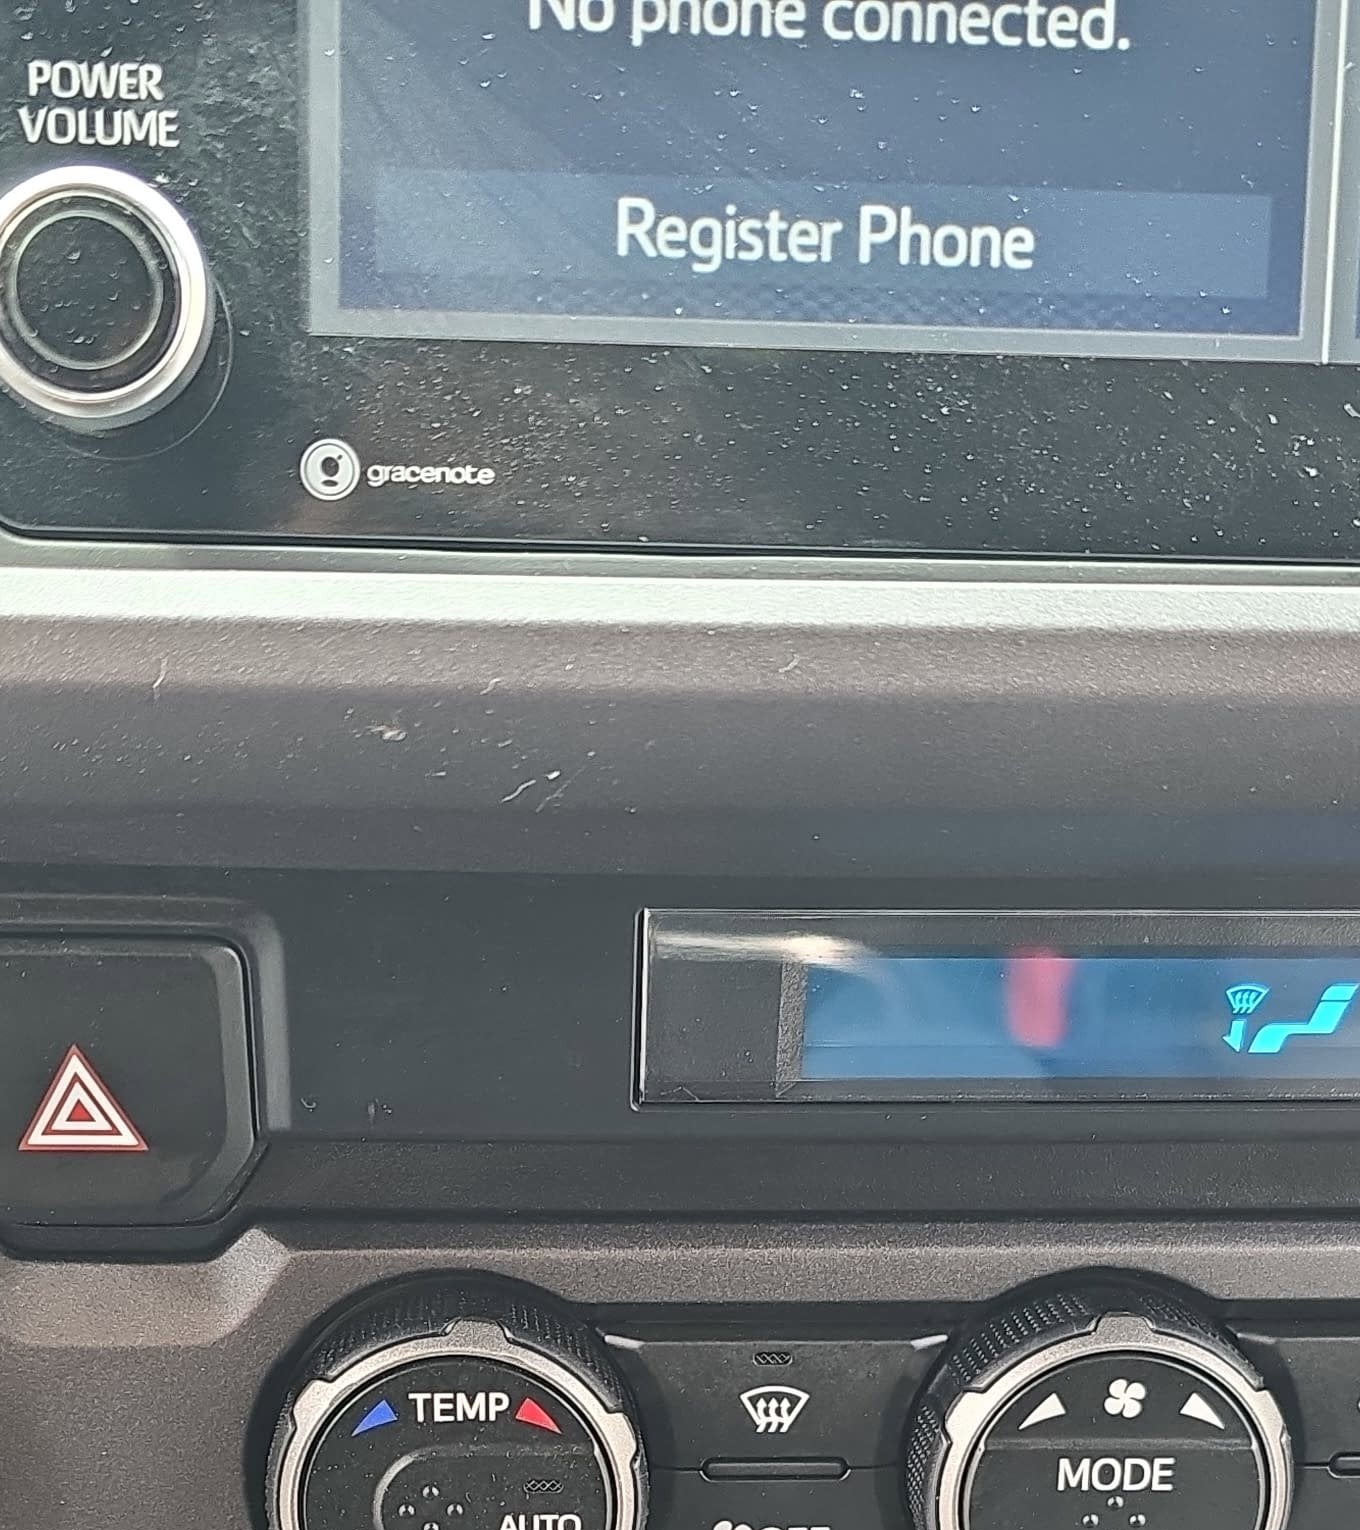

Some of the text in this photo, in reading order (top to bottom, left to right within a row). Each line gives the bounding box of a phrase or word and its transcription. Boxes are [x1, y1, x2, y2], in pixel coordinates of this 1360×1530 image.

[630, 0, 806, 46] phone
[823, 0, 1130, 50] connected.
[28, 60, 164, 100] POWER
[18, 106, 179, 147] VOLUME
[618, 197, 1034, 273] Register Phone
[367, 465, 495, 486] gracenote
[409, 1392, 509, 1422] TEMP
[1058, 1458, 1174, 1490] MODE
